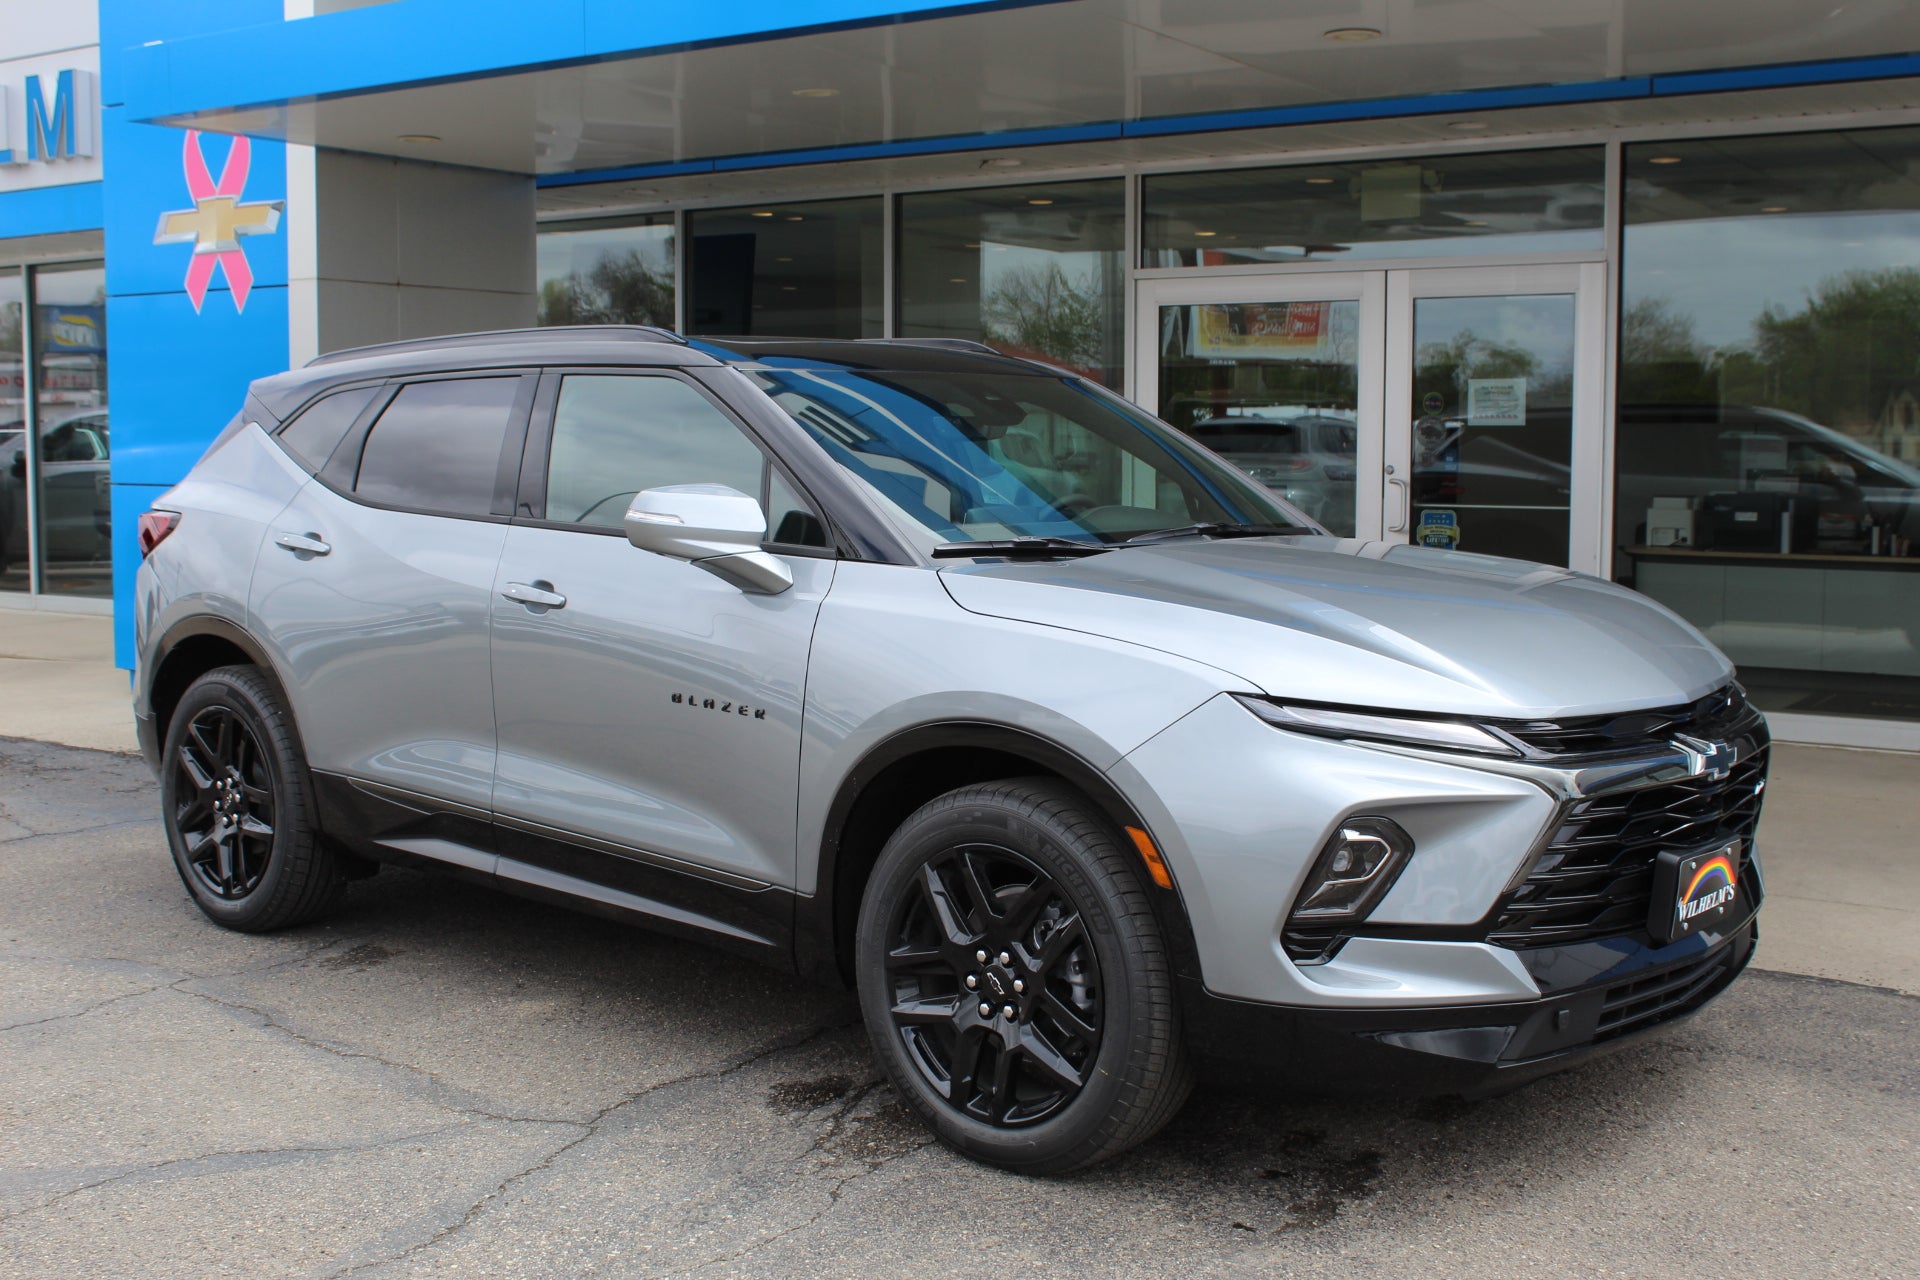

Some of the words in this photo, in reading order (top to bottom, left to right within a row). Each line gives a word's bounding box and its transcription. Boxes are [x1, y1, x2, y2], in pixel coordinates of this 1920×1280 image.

[0, 69, 77, 163] M
[671, 692, 766, 720] BLAZER
[1041, 844, 1112, 935] MICHELIN
[1677, 883, 1735, 921] WILHELM'S
